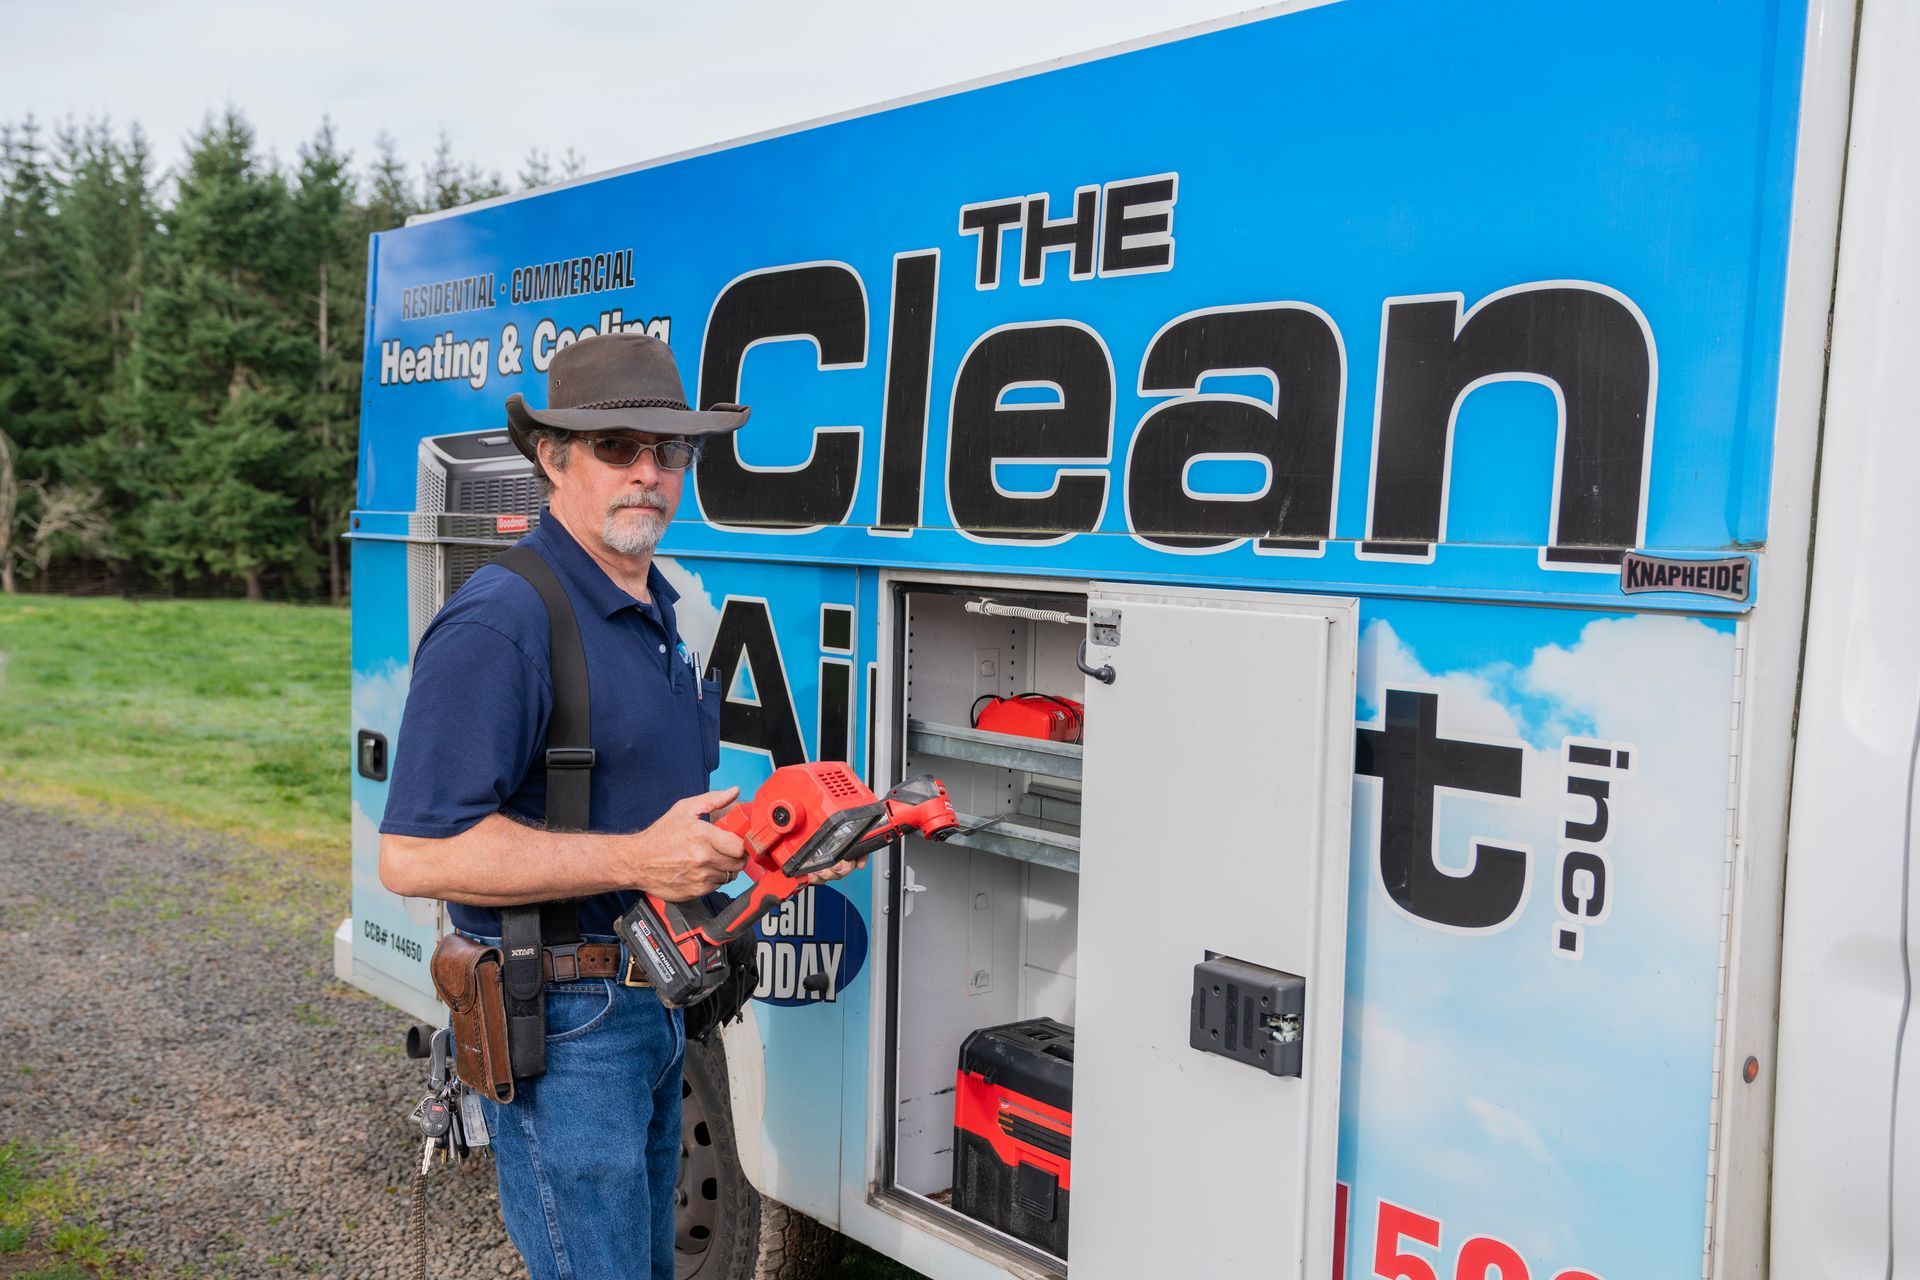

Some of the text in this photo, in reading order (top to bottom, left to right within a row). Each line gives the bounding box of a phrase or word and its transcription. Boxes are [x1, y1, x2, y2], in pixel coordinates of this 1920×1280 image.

[960, 173, 1178, 290] THE
[402, 249, 635, 321] RESIDENTIAL COMMERCIAL
[380, 331, 489, 390] Heating
[497, 323, 524, 376] &
[694, 248, 1658, 572] Clean
[1625, 558, 1745, 595] KNAPHEIDE
[702, 594, 877, 790] Ai
[1554, 739, 1635, 958] inc.
[364, 920, 422, 962] CCB# 144650
[511, 948, 535, 957] XTAR
